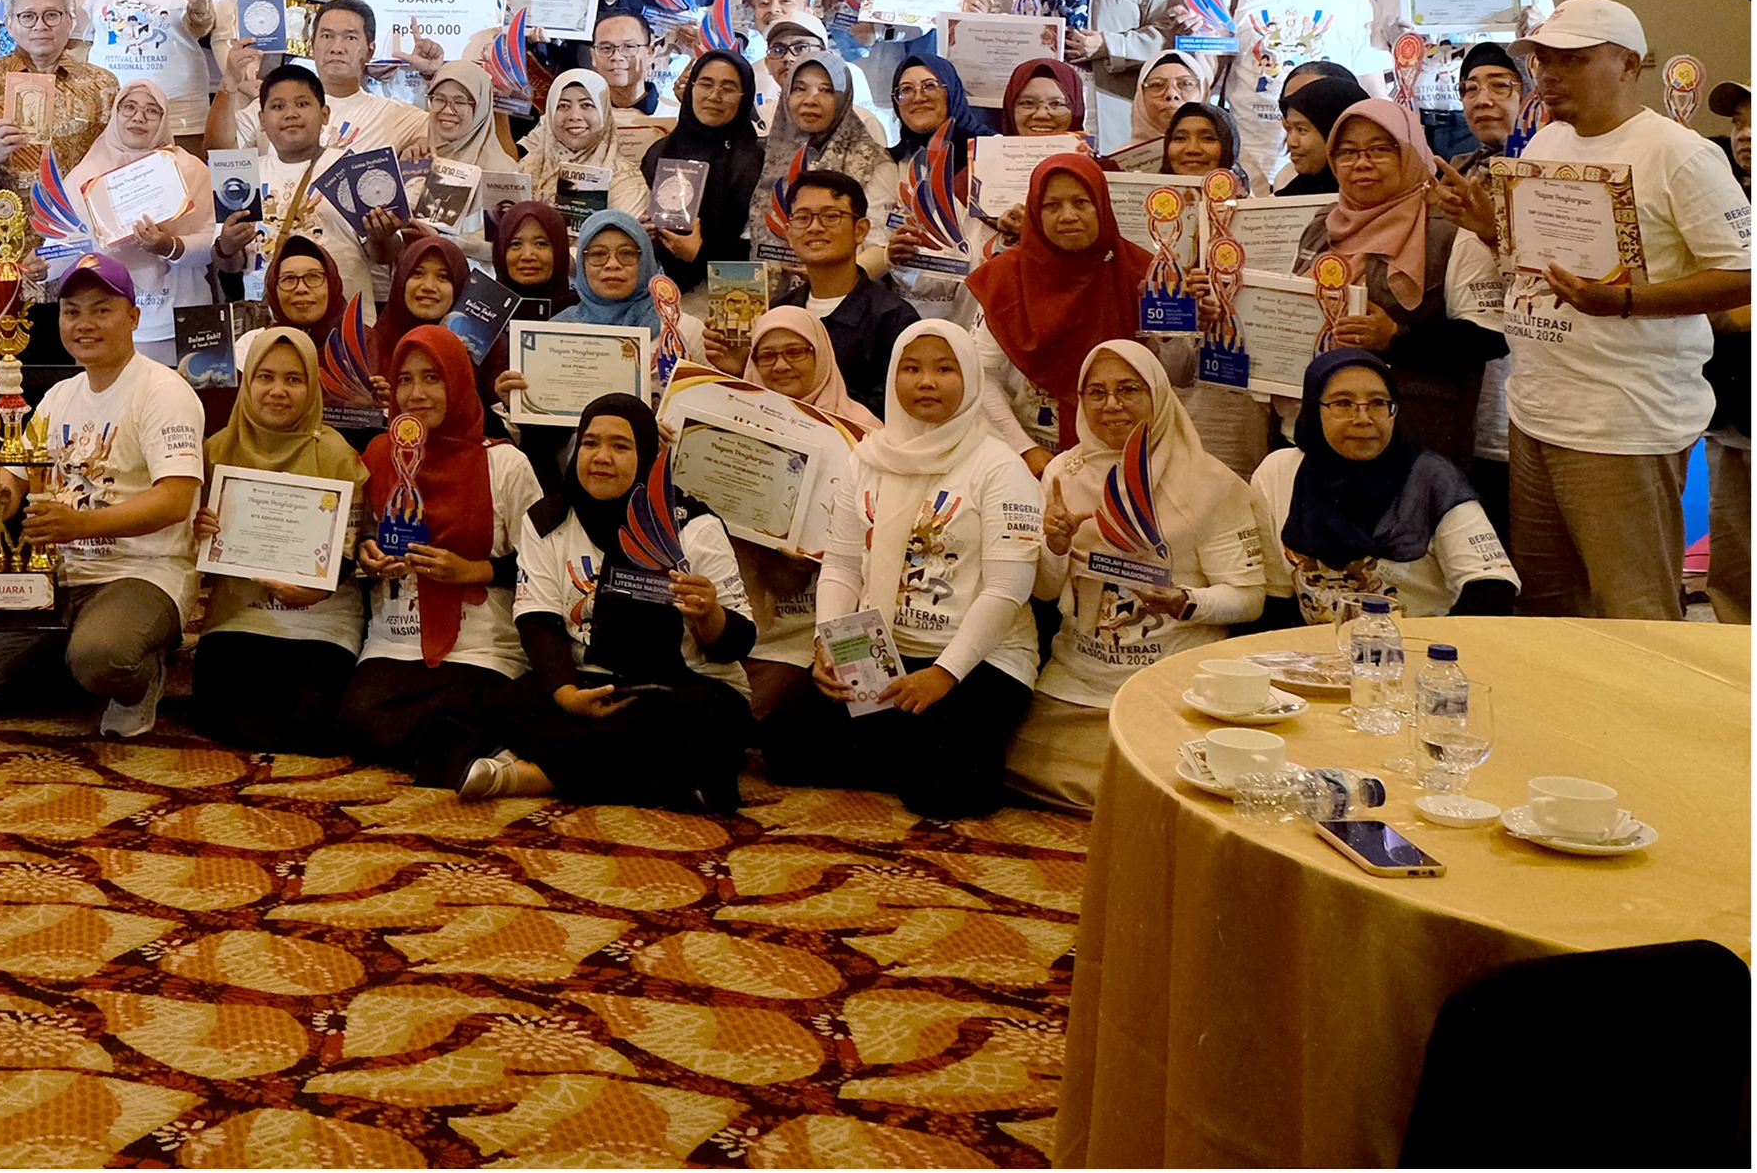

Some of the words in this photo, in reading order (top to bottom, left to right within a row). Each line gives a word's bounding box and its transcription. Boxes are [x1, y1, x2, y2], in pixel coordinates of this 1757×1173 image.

[135, 55, 168, 64] LITERASI
[109, 63, 145, 71] NASIONAL
[214, 160, 252, 168] MINUSTIGA
[351, 162, 366, 170] Gema
[366, 157, 389, 167] Peristiwa
[562, 169, 586, 181] KLANA
[486, 183, 526, 192] MINUSTIGA
[37, 245, 59, 255] SEKOLAH
[760, 246, 783, 254] SEKOLAH
[759, 252, 783, 260] LITERASI
[147, 296, 165, 306] 2026
[1147, 308, 1164, 319] 50
[1523, 316, 1573, 333] LITERASI
[188, 334, 206, 344] Bulan
[1536, 330, 1564, 344] 2026
[571, 349, 611, 358] Penghargaan
[1204, 359, 1219, 371] 10
[342, 415, 370, 423] NASIONAL
[270, 499, 309, 511] Penghargaan
[78, 536, 117, 546] LITERASI
[384, 533, 399, 542] 10
[1093, 555, 1122, 567] SEKOLAH
[1123, 561, 1166, 577] BERDEDIKASI
[615, 572, 645, 583] SEKOLAH
[1092, 562, 1120, 575] LITERASI
[1121, 569, 1154, 583] NASIONAL
[28, 586, 33, 594] 1
[614, 579, 643, 590] LITERASI
[385, 614, 421, 625] FESTIVAL
[898, 608, 950, 625] LITERASI
[390, 625, 421, 636] NASION
[915, 620, 943, 631] 2026
[1076, 642, 1124, 665] NASIONAL
[1127, 655, 1155, 665] 2026
[1108, 643, 1162, 654] LITERASI
